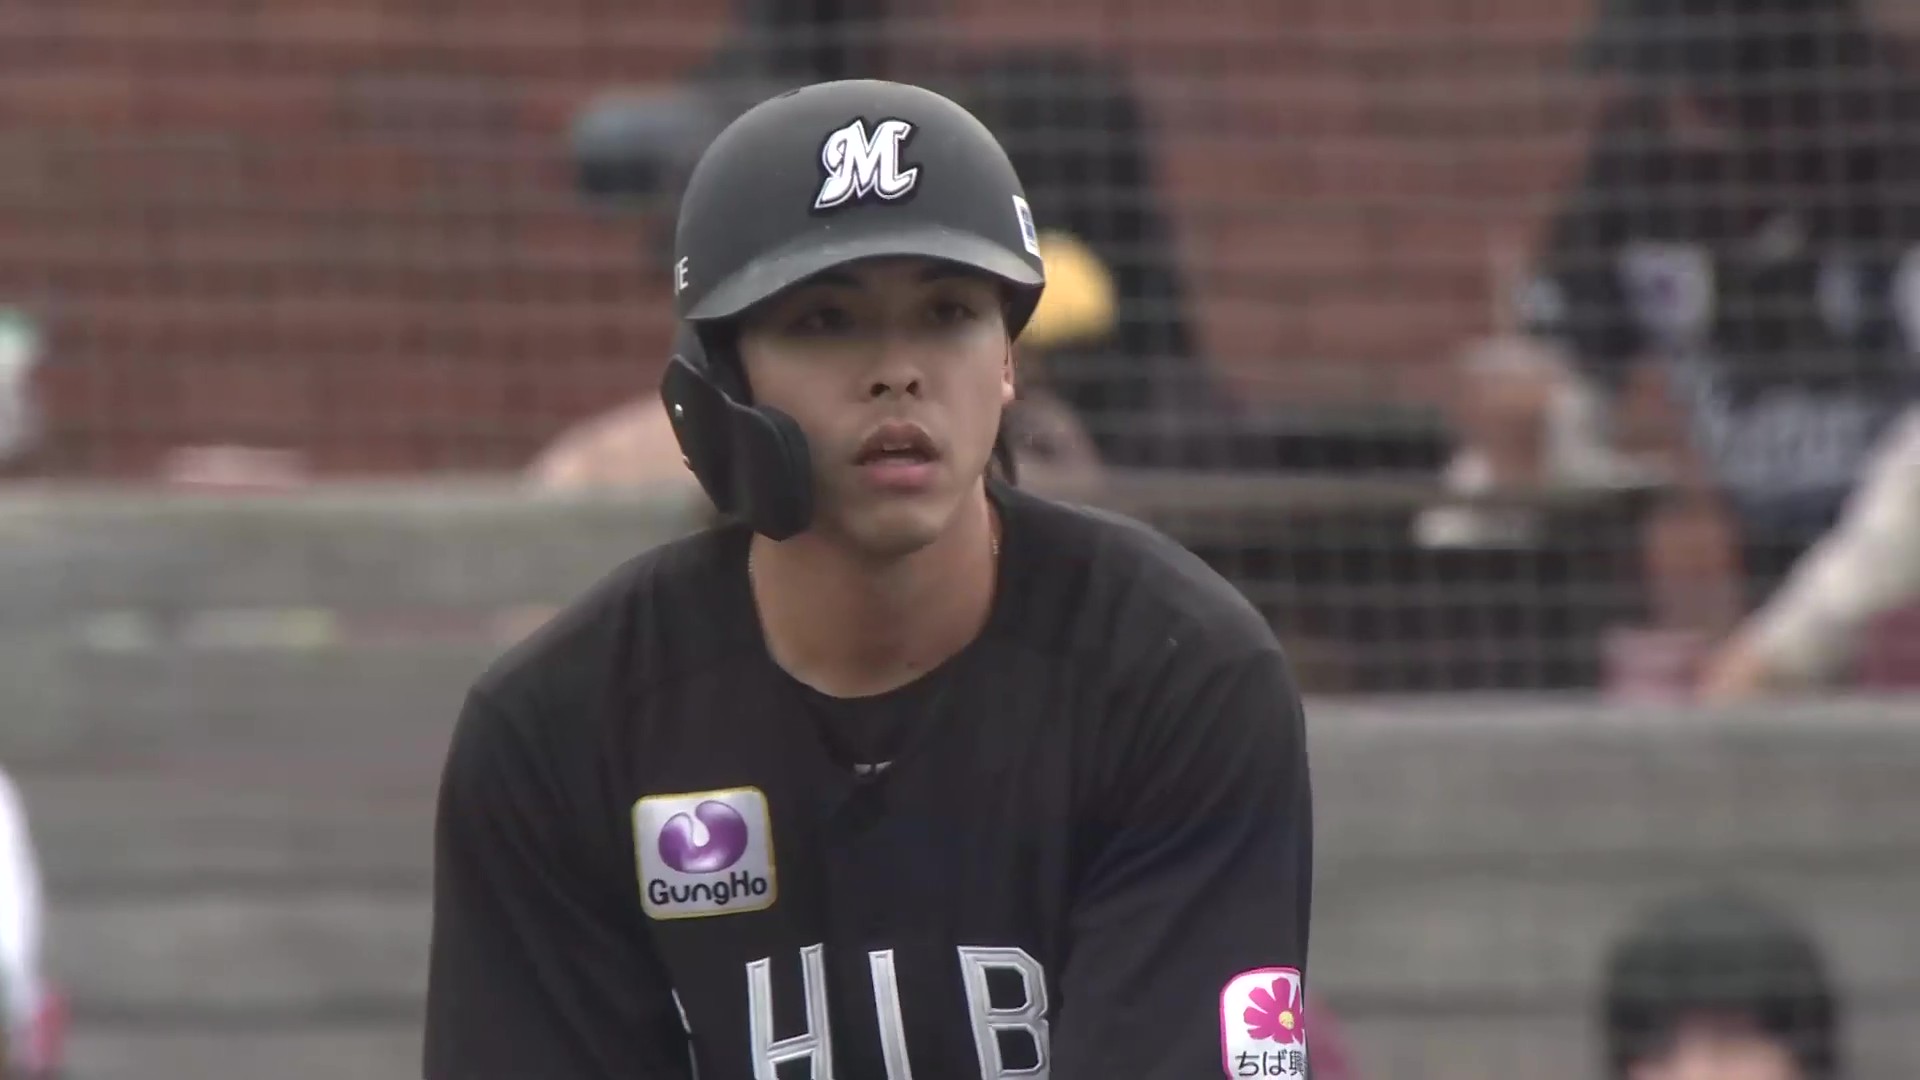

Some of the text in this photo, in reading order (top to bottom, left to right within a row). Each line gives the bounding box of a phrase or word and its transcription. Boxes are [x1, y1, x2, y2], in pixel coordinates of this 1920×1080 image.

[813, 118, 918, 209] M
[648, 870, 768, 906] GungHo
[672, 943, 1050, 1080] HIB
